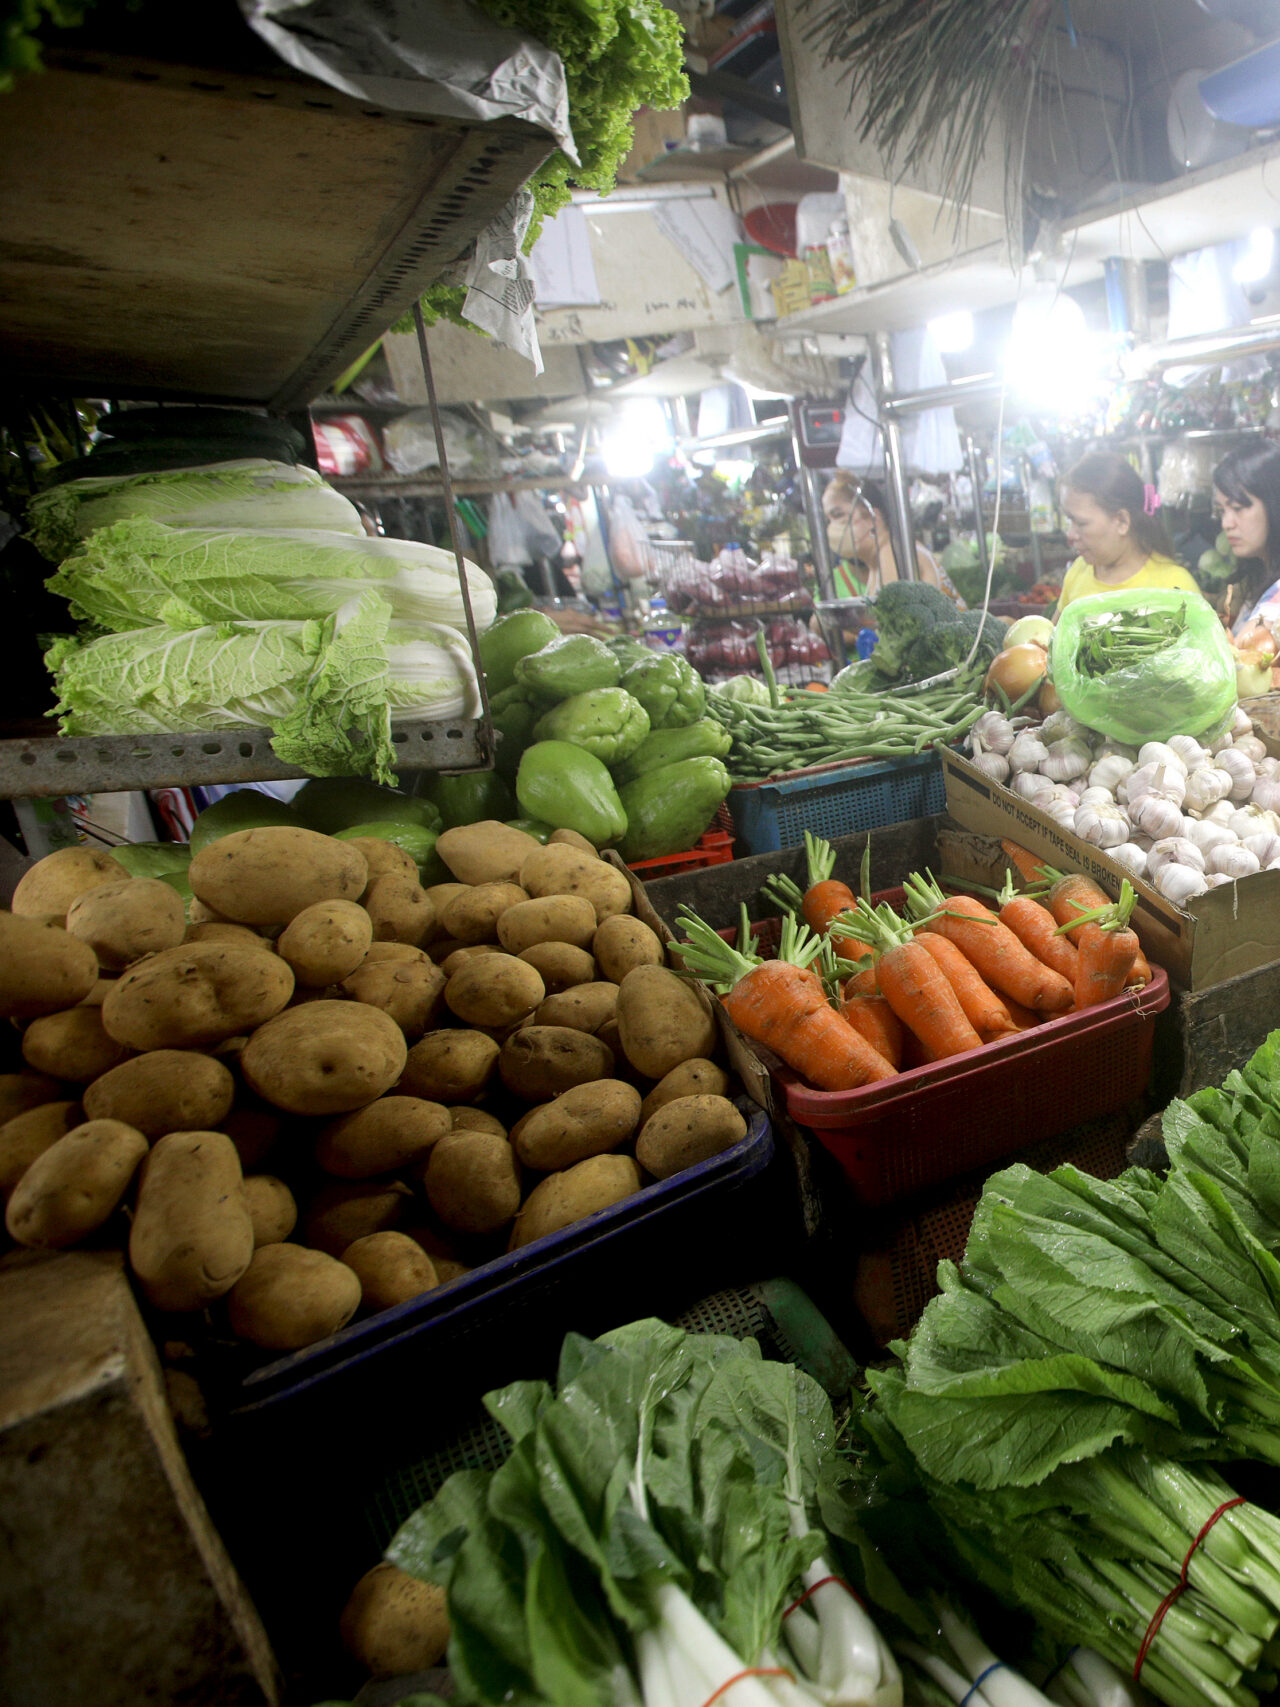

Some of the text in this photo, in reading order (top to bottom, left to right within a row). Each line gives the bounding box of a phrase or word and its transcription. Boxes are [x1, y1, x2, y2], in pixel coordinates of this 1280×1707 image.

[992, 790, 1120, 891] DO NOT ACCEPT IF TAPE SEAL IS BROKEN
